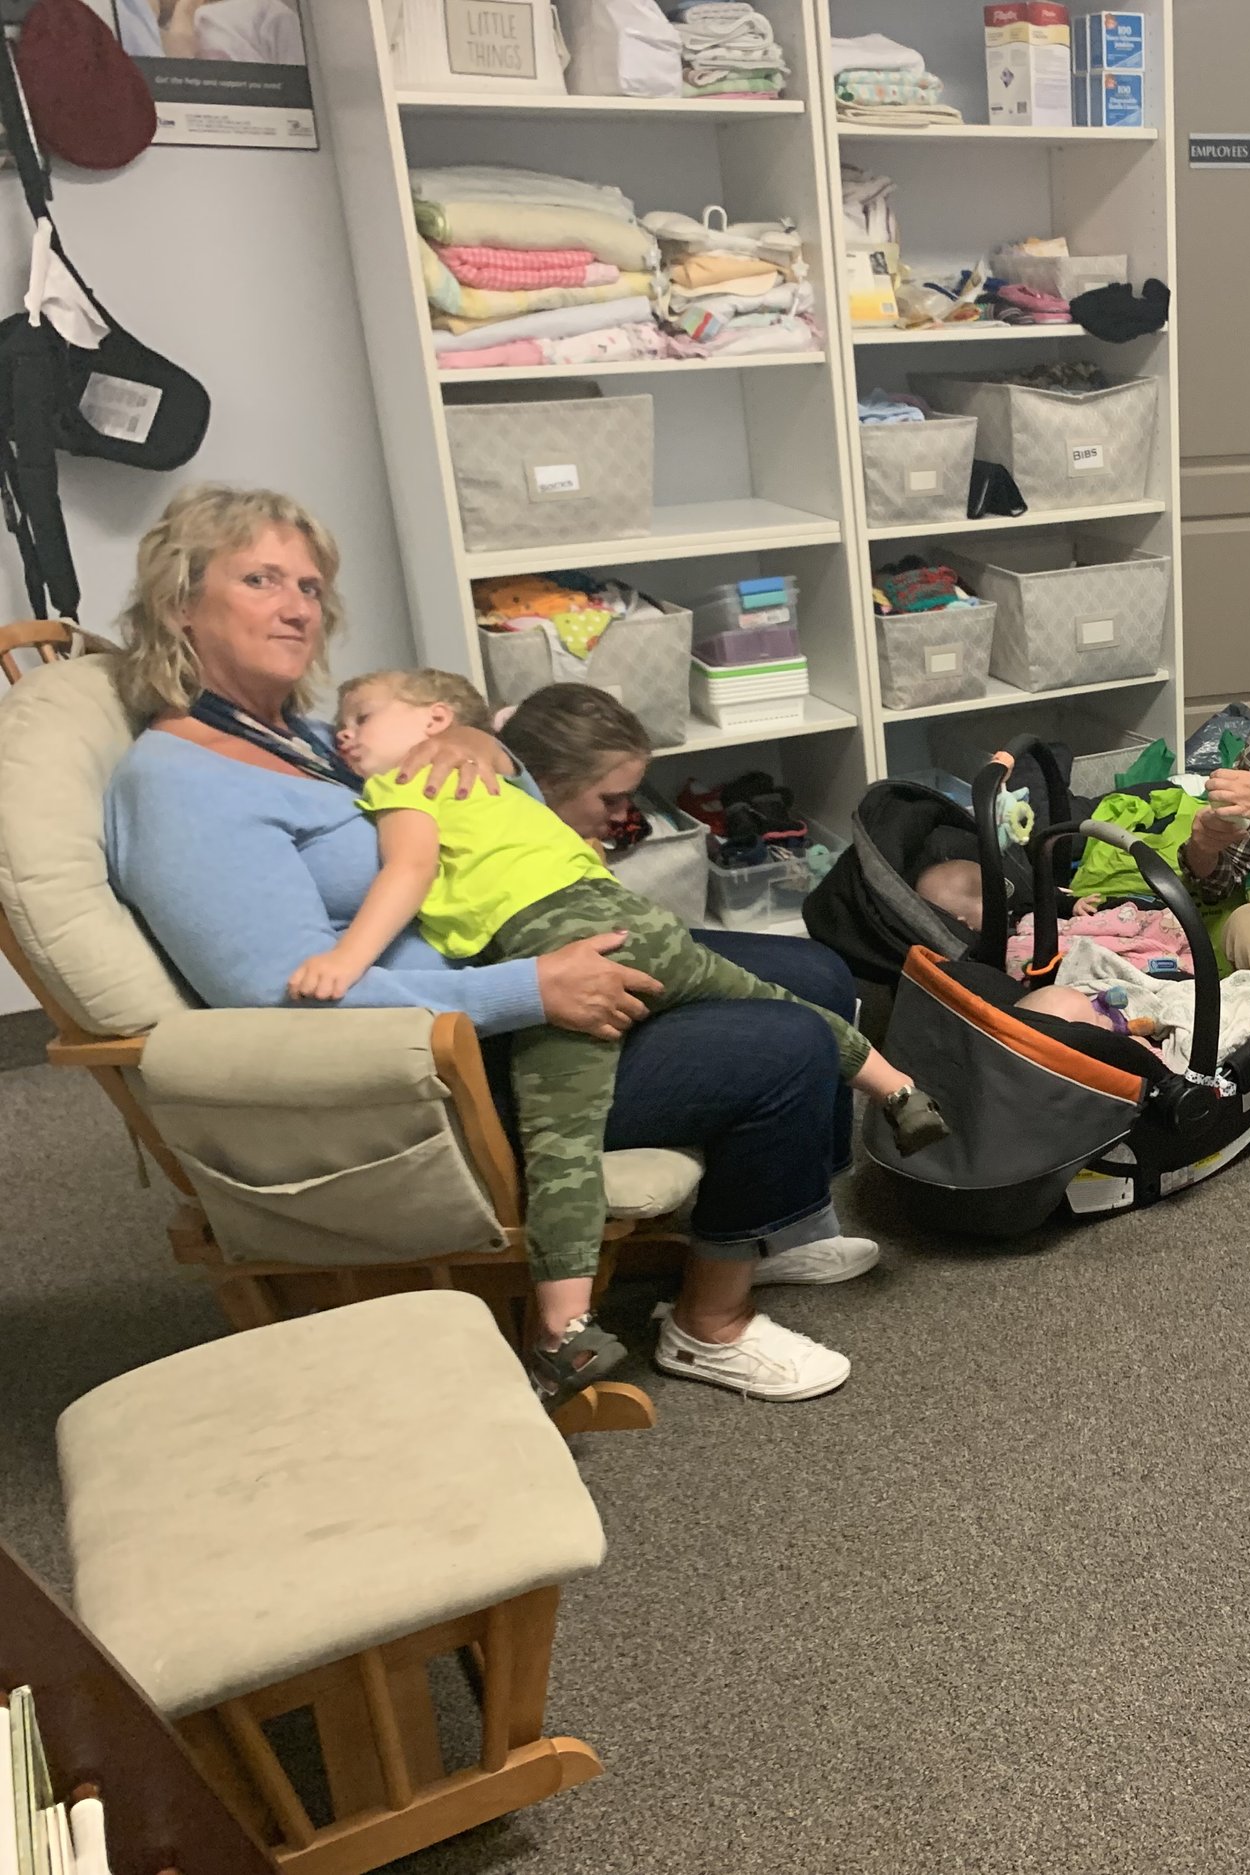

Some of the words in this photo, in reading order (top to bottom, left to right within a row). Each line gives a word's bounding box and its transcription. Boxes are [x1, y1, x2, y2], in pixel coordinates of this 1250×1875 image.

[466, 9, 518, 40] LITTLE
[466, 40, 522, 71] THINGS
[184, 77, 201, 87] help
[202, 78, 218, 87] and
[218, 80, 247, 89] support
[1191, 145, 1249, 158] EMPLOYEES
[1072, 448, 1098, 461] BIBS
